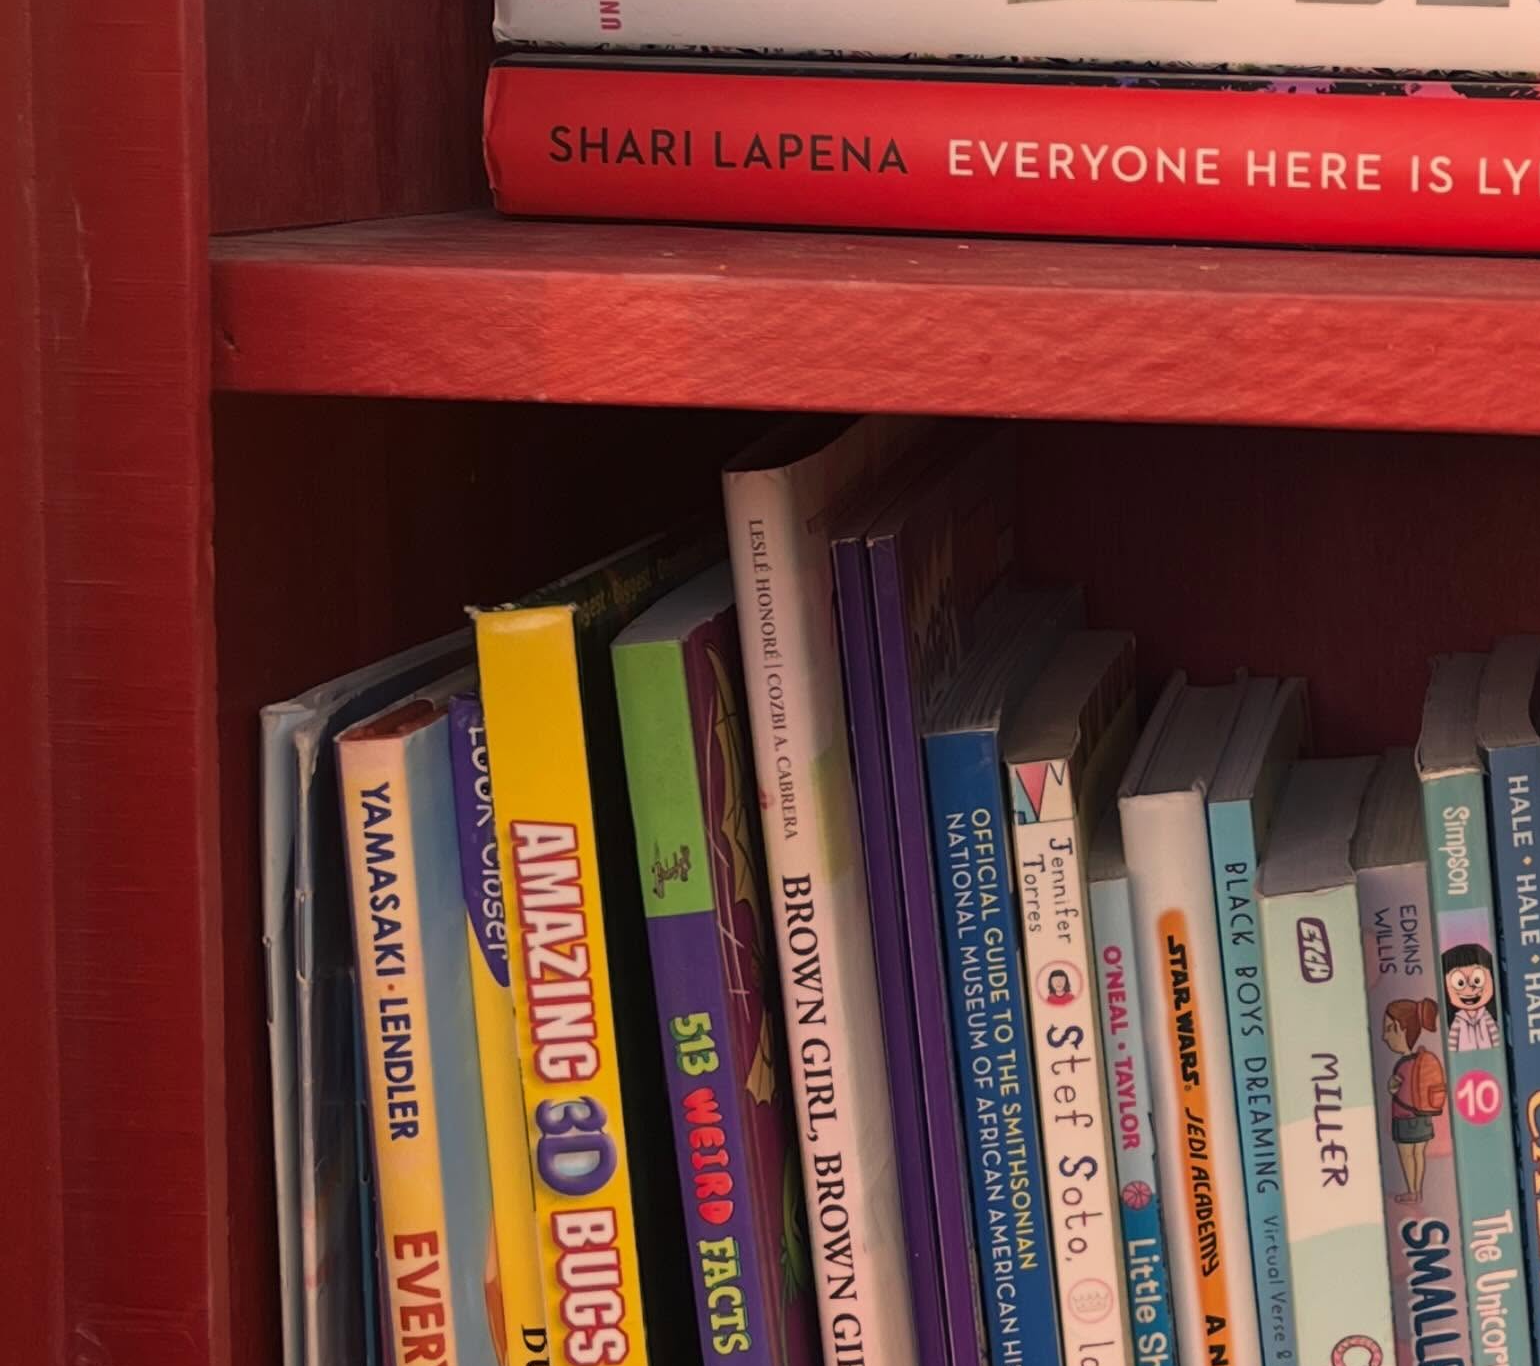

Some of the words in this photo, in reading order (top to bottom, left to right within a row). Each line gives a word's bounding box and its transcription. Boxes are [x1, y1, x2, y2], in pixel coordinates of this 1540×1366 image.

[549, 126, 692, 166] SHARI
[714, 131, 909, 174] LAPENA
[948, 139, 1220, 187] EVERYONE
[1246, 149, 1382, 192] HERE
[1410, 155, 1454, 194] IS
[1438, 806, 1471, 896] Simpson
[1507, 775, 1534, 848] HALE
[360, 781, 405, 978] YAMASAKI
[946, 813, 974, 940] NATIONAL
[971, 808, 999, 920] OFFICIAL
[1023, 854, 1045, 933] Torres
[1049, 837, 1079, 944] Jennifer
[1224, 862, 1254, 945] BLACK
[510, 820, 600, 1083] AMAZING
[781, 873, 827, 1026] BROWN
[984, 929, 1010, 1004] GUIDE
[1167, 935, 1190, 1011] STAR
[1374, 906, 1397, 975] WILLIS
[1400, 904, 1423, 976] EDKINS
[960, 946, 987, 1051] MUSEUM
[993, 1006, 1012, 1043] TO
[1102, 945, 1129, 1036] O'NEAL
[1234, 965, 1264, 1037] BOYS
[379, 997, 419, 1142] LENDLER
[670, 1012, 720, 1077] 513
[972, 1056, 993, 1089] OF
[995, 1049, 1019, 1095] THE
[1173, 1012, 1200, 1085] WARS
[801, 1038, 838, 1143] GIRL,
[1115, 1056, 1142, 1151] TAYLOR
[1244, 1056, 1279, 1194] DREAMING
[1457, 1078, 1499, 1118] 10
[536, 1097, 618, 1197] 3D
[683, 1087, 734, 1226] WEIRD
[975, 1097, 1005, 1202] AFRICAN
[1184, 1106, 1208, 1169] JEDI
[813, 1152, 857, 1303] BROWN
[1002, 1102, 1038, 1270] SMITHSONIAN
[1191, 1166, 1220, 1278] ACADEMY
[988, 1208, 1020, 1333] AMERICAN
[1262, 1216, 1286, 1288] Virtual
[1470, 1209, 1513, 1263] The
[697, 1236, 751, 1356] FACTS
[1126, 1238, 1161, 1324] Little
[1270, 1291, 1287, 1342] Verse
[1204, 1314, 1227, 1336] A
[1275, 1349, 1287, 1364] &
